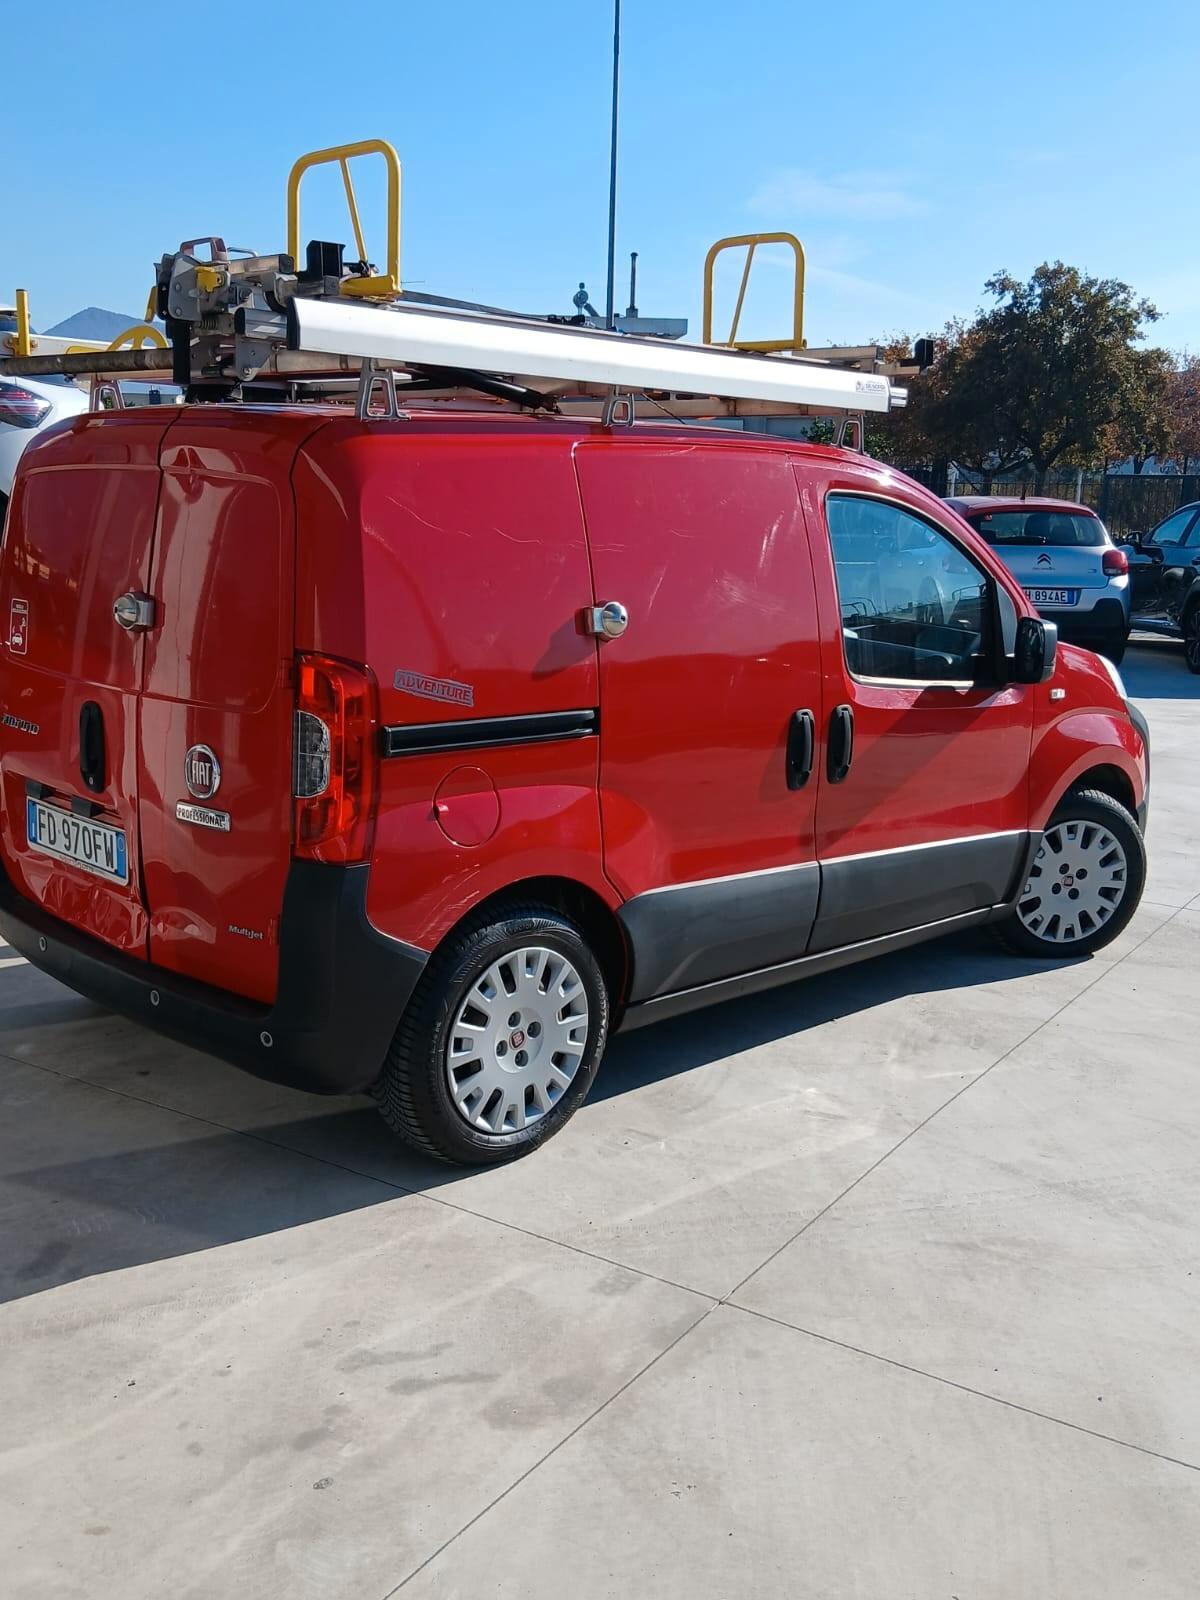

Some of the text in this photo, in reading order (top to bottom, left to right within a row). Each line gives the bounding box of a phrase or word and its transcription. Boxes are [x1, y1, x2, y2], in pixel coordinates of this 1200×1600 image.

[1034, 590, 1067, 602] 894AE
[397, 673, 472, 700] ADVENTURE
[191, 760, 211, 786] FIAT
[178, 807, 226, 827] PROFESSIONAL
[38, 808, 57, 846] FD
[62, 818, 115, 869] 970FW
